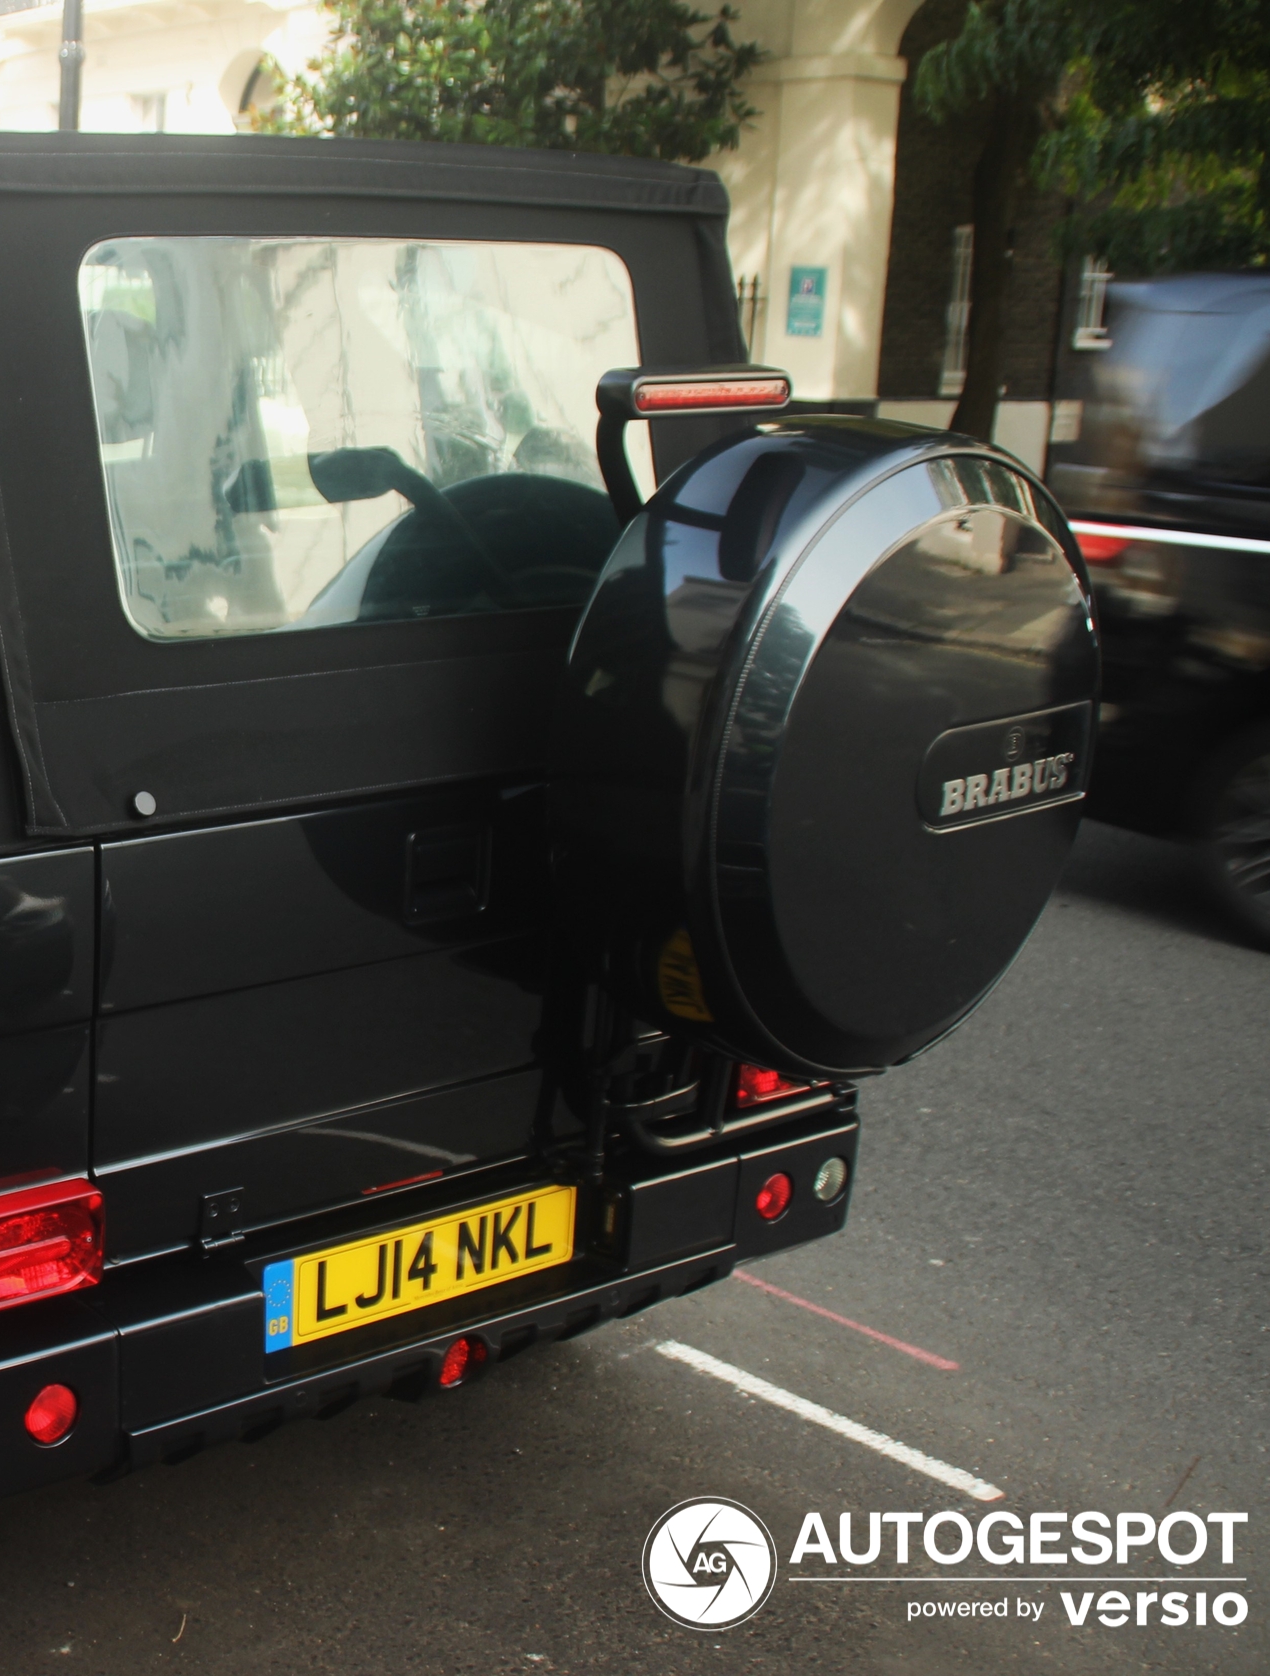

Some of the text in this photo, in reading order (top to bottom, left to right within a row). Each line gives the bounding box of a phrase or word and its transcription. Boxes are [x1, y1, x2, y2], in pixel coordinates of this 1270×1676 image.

[939, 753, 1071, 817] BRABUS
[316, 1202, 553, 1322] LJ14 NKL
[268, 1316, 289, 1336] GB
